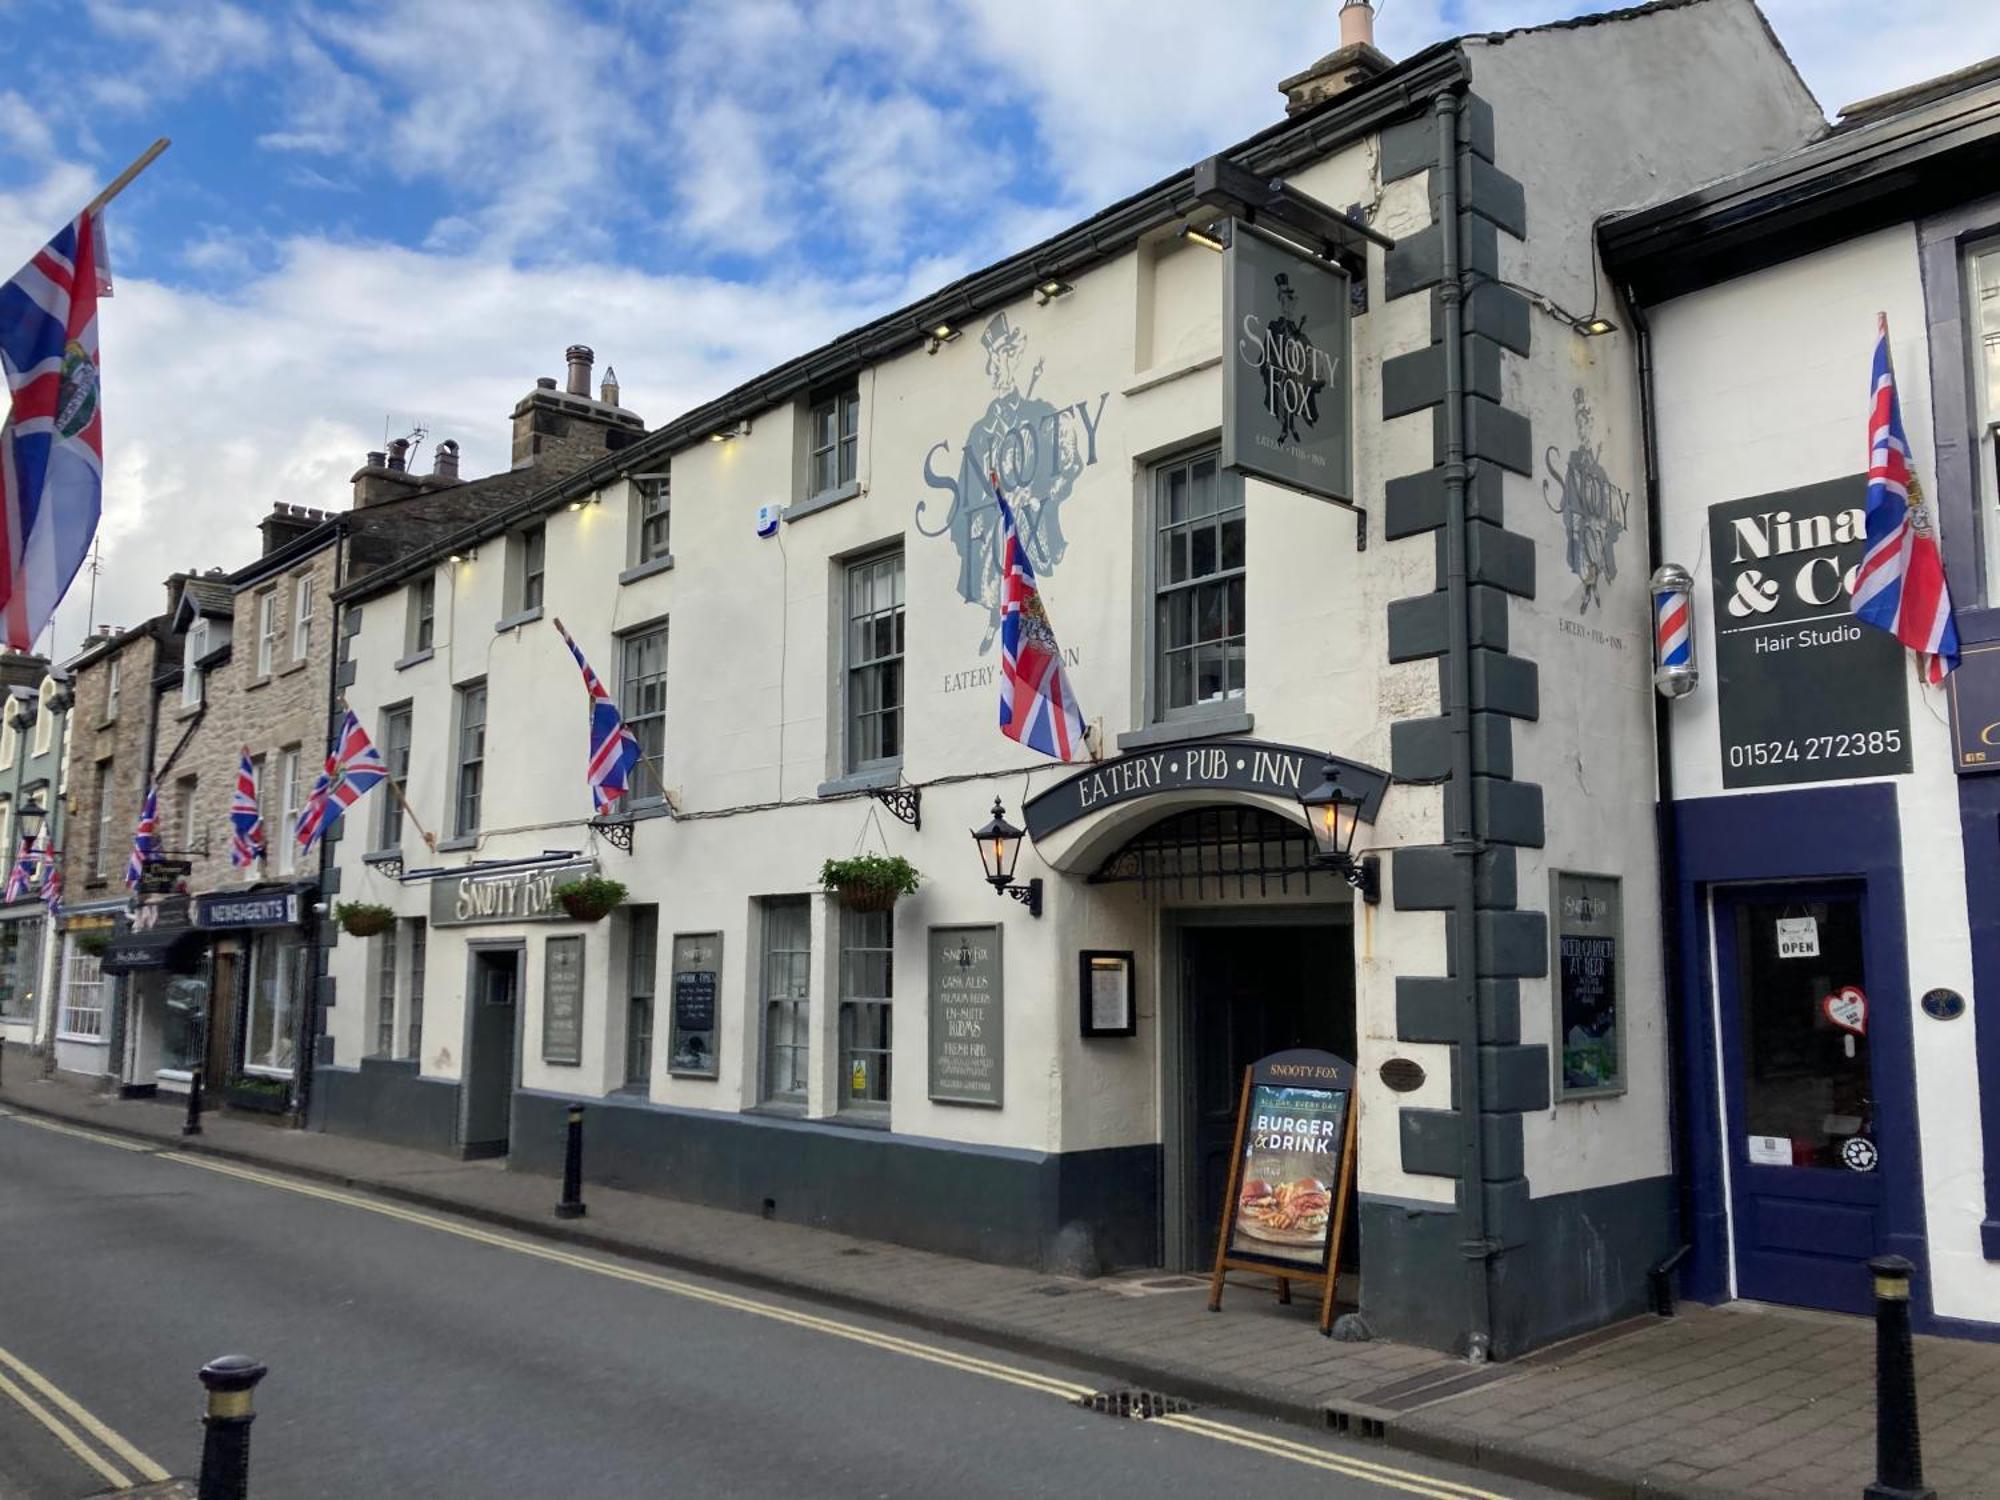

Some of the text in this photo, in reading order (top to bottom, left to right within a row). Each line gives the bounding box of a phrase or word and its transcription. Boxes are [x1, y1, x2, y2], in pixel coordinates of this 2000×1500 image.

[1239, 314, 1340, 389] SNOOTY
[1269, 364, 1314, 421] FOX
[915, 391, 1110, 538] SNOOTY
[1730, 507, 1867, 564] Nina
[1727, 569, 1780, 617] &
[1754, 625, 1862, 654] Hair Studio
[943, 663, 996, 693] EATERY
[1729, 729, 1902, 768] 01524 272385
[1078, 749, 1304, 809] EATERY PUB INN
[210, 899, 283, 922] NEWSAGENTS
[456, 869, 556, 921] SNOOTY FOX
[1782, 941, 1814, 954] OPEN
[1269, 1064, 1339, 1079] SNOOTY FOX
[1257, 1115, 1335, 1137] BURGER
